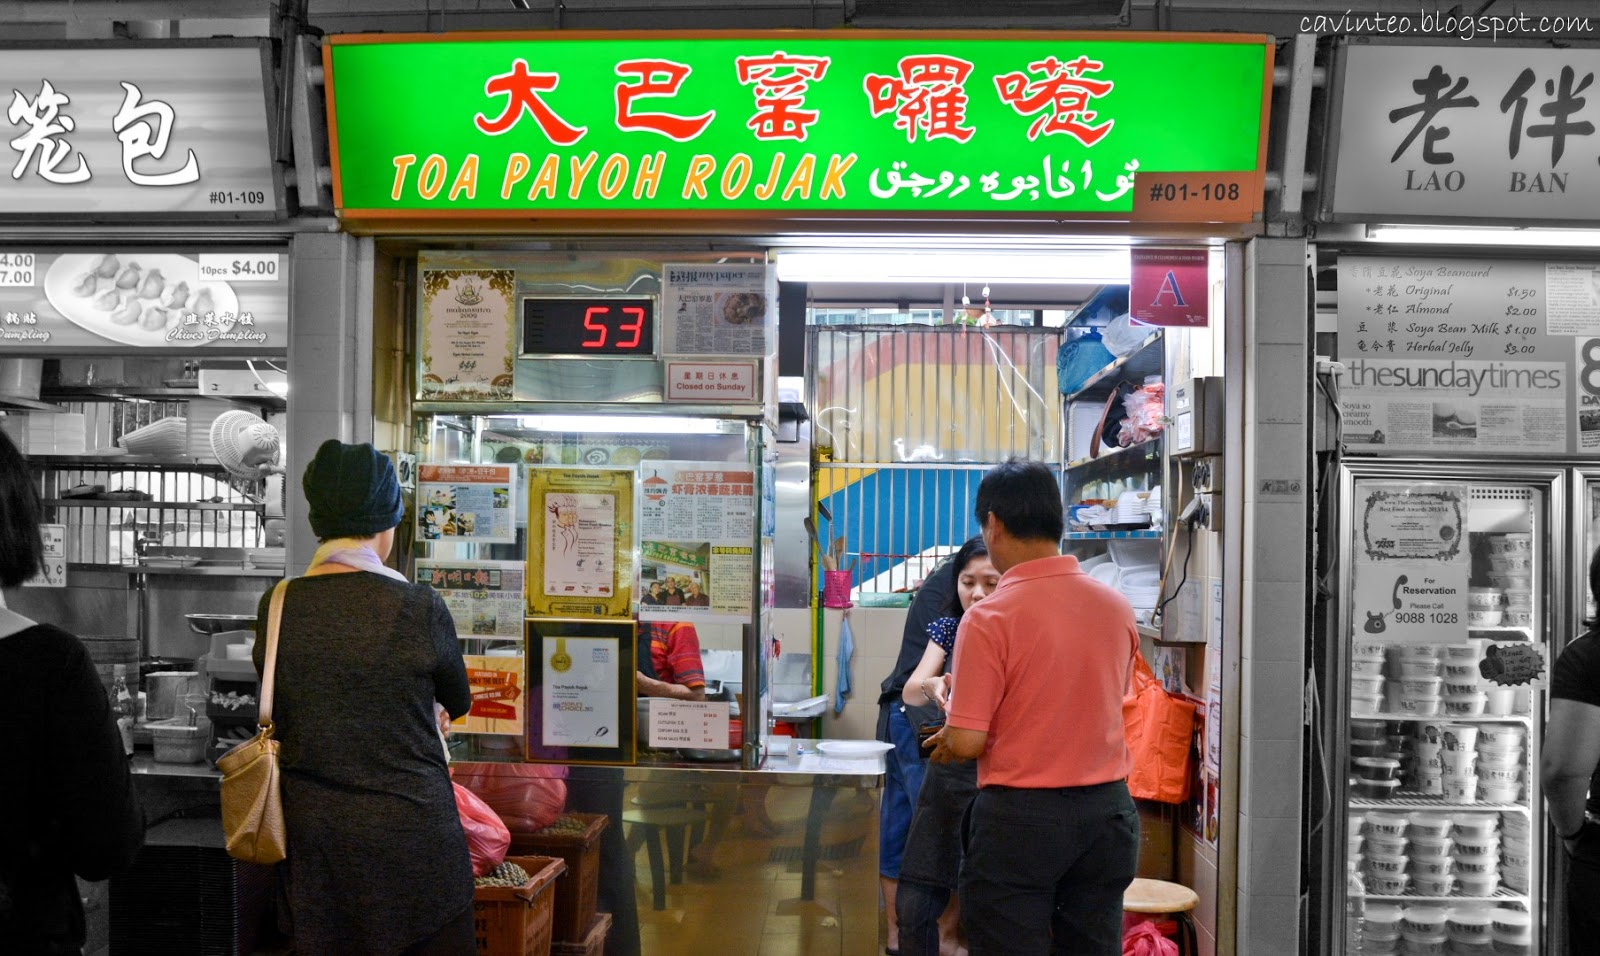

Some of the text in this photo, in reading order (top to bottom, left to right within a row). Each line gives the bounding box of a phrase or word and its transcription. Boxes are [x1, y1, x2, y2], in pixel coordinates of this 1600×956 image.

[391, 151, 859, 201] TOA PAYOH ROJAK
[1404, 170, 1569, 193] LAO BAN
[209, 191, 266, 205] #01-109
[1149, 183, 1241, 202] #01-108
[201, 259, 276, 277] 10pcs $4.00
[1405, 265, 1434, 281] Soya
[1436, 265, 1493, 278] Beancurd
[1150, 269, 1189, 307] A
[1405, 283, 1453, 300] Original
[1507, 286, 1536, 298] $1.50
[1405, 302, 1453, 315] Almond
[1505, 305, 1537, 317] $2.00
[581, 307, 645, 348] 53
[1405, 322, 1434, 338] Soya
[1438, 323, 1467, 335] Bean
[1471, 321, 1501, 336] Milk
[165, 329, 268, 343] Chives Dumpling
[1406, 340, 1447, 353] Herbal
[1448, 340, 1474, 357] Jelly
[1504, 343, 1536, 355] $3.00
[683, 371, 739, 380] 星期日休息
[1348, 358, 1561, 397] thesundaytimes
[676, 382, 703, 390] Closed
[716, 383, 746, 392] Sunday
[1342, 402, 1360, 411] Soya
[1582, 396, 1600, 405] DA
[1343, 418, 1372, 426] smooth
[1402, 586, 1457, 595] Reservation
[1410, 602, 1445, 610] Please Call
[1395, 612, 1459, 625] 9088 1028
